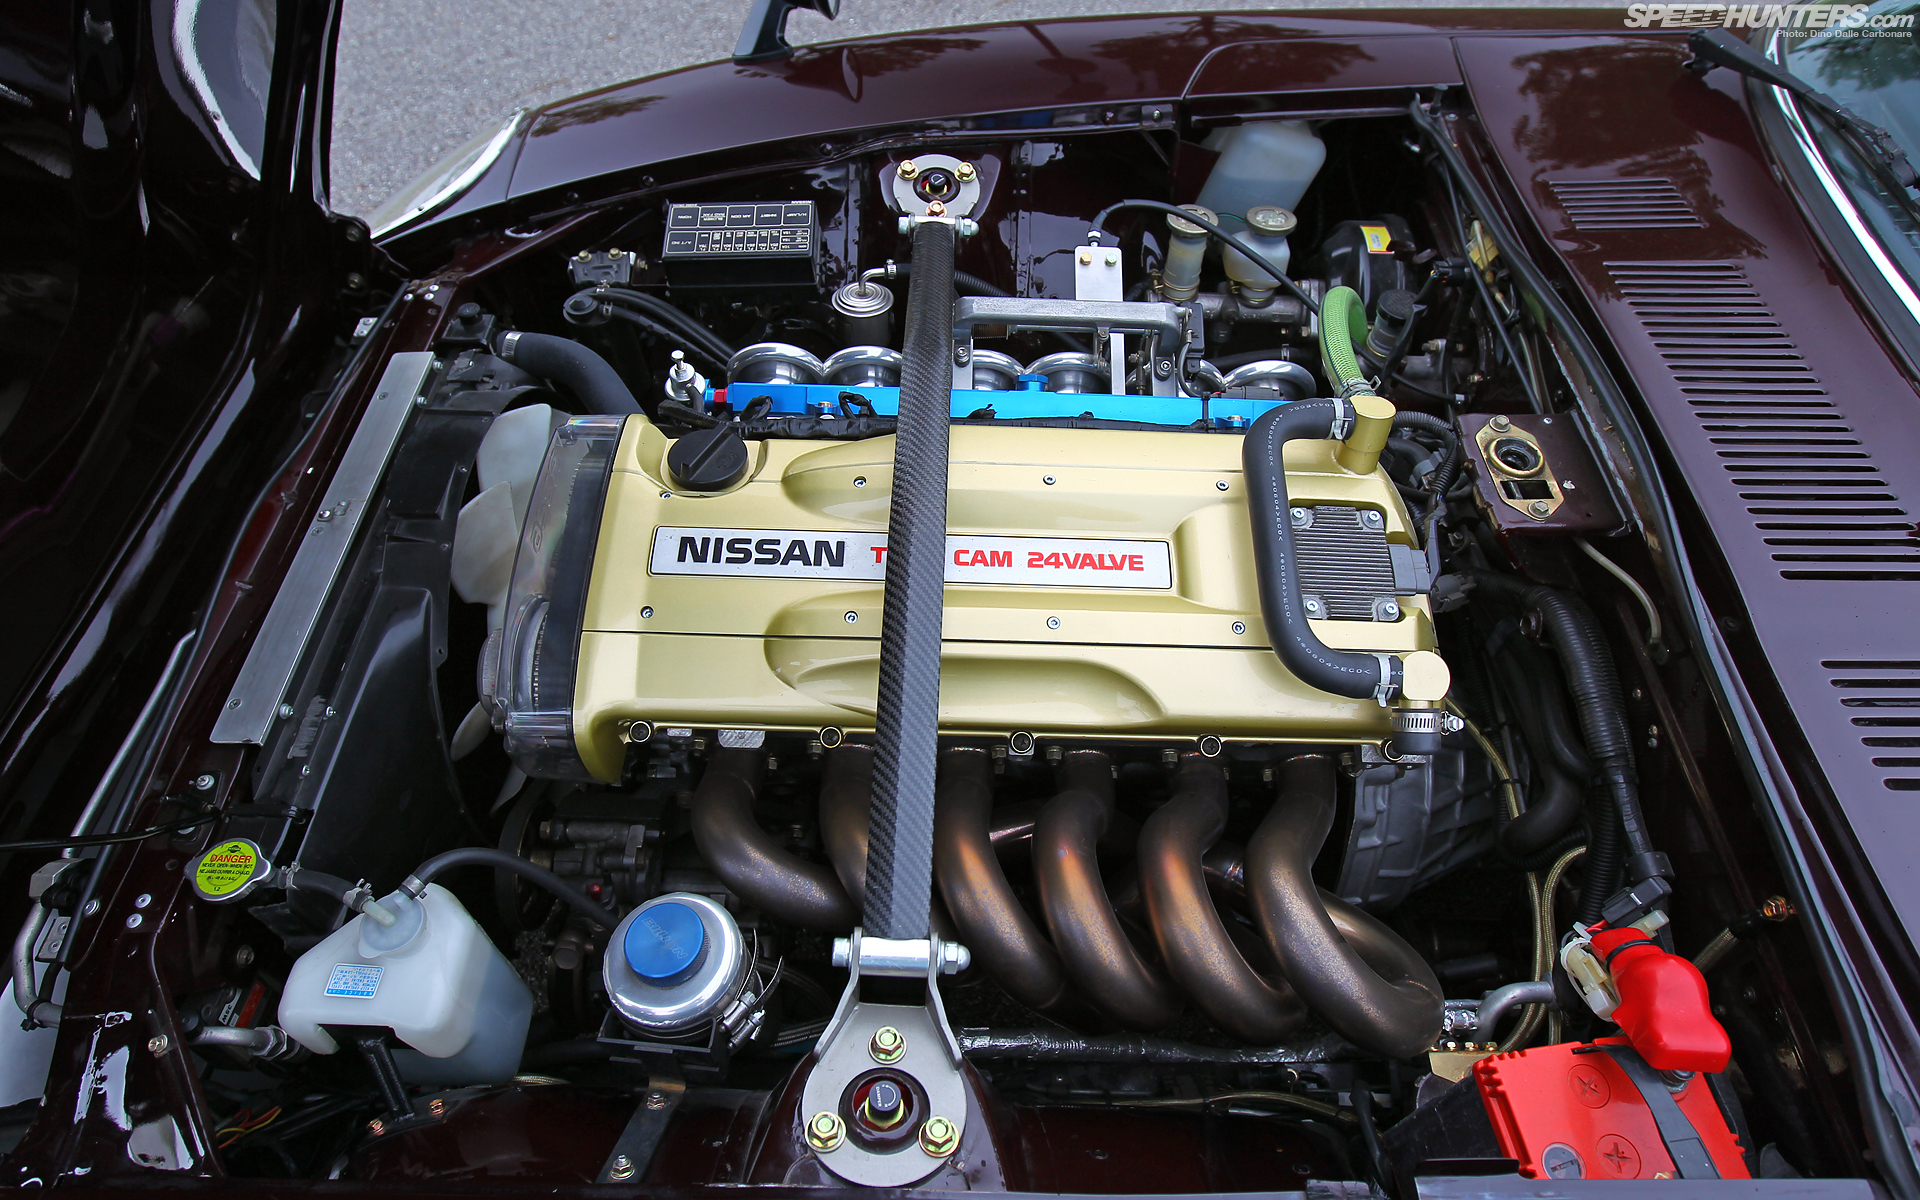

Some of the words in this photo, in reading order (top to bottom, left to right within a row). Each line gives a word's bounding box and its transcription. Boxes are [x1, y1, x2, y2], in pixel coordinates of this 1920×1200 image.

[677, 536, 846, 567] NISSAN
[954, 549, 1013, 568] CAM
[1027, 550, 1145, 571] 24VALVE
[210, 854, 252, 863] DANGER
